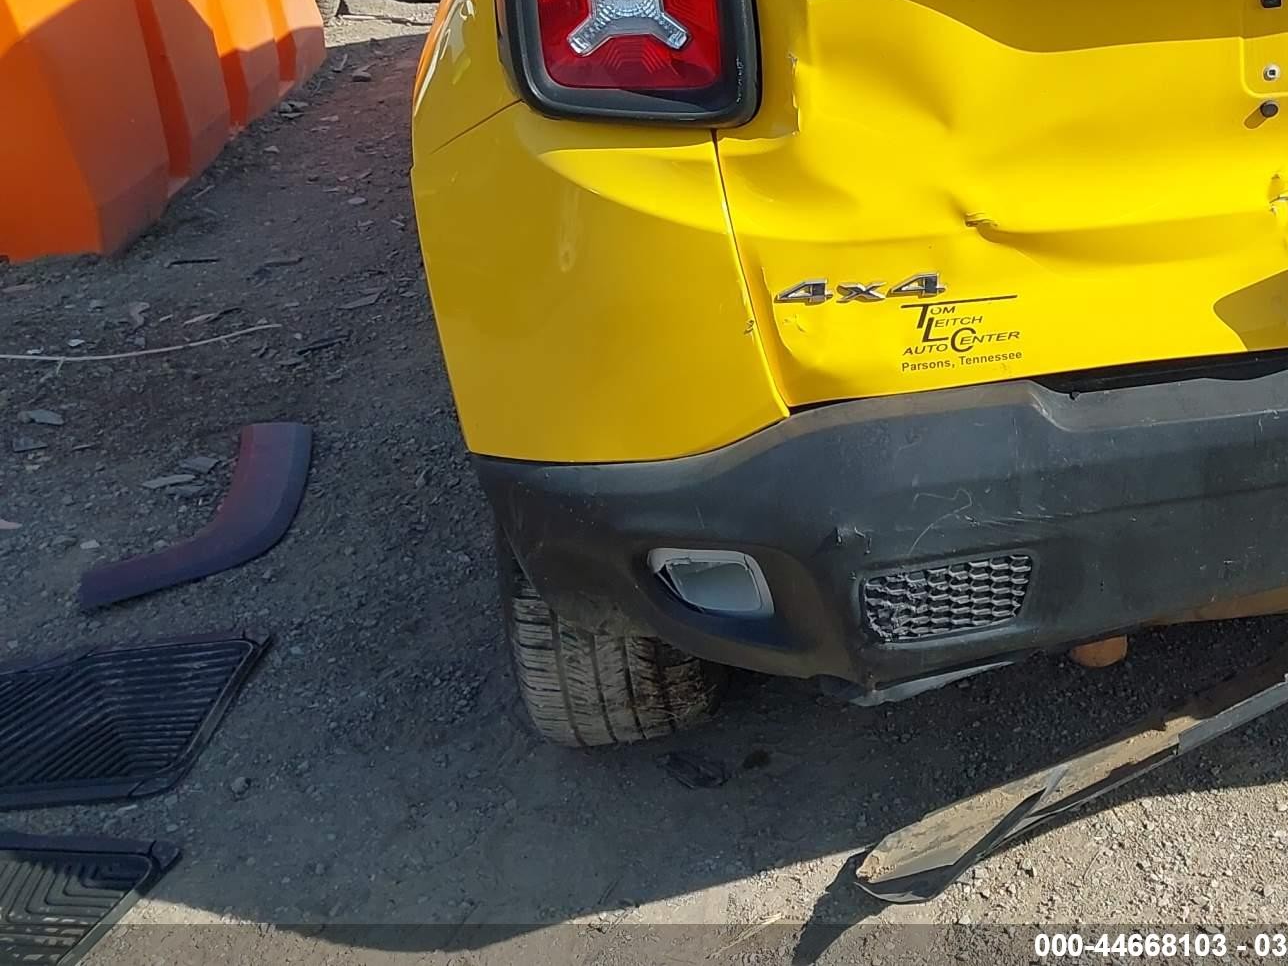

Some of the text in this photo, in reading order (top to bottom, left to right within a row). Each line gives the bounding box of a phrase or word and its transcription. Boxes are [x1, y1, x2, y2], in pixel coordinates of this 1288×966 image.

[902, 327, 1021, 356] AUTO CENTER
[922, 316, 983, 343] LEITCH
[901, 351, 1023, 372] Parsons, Tennessee
